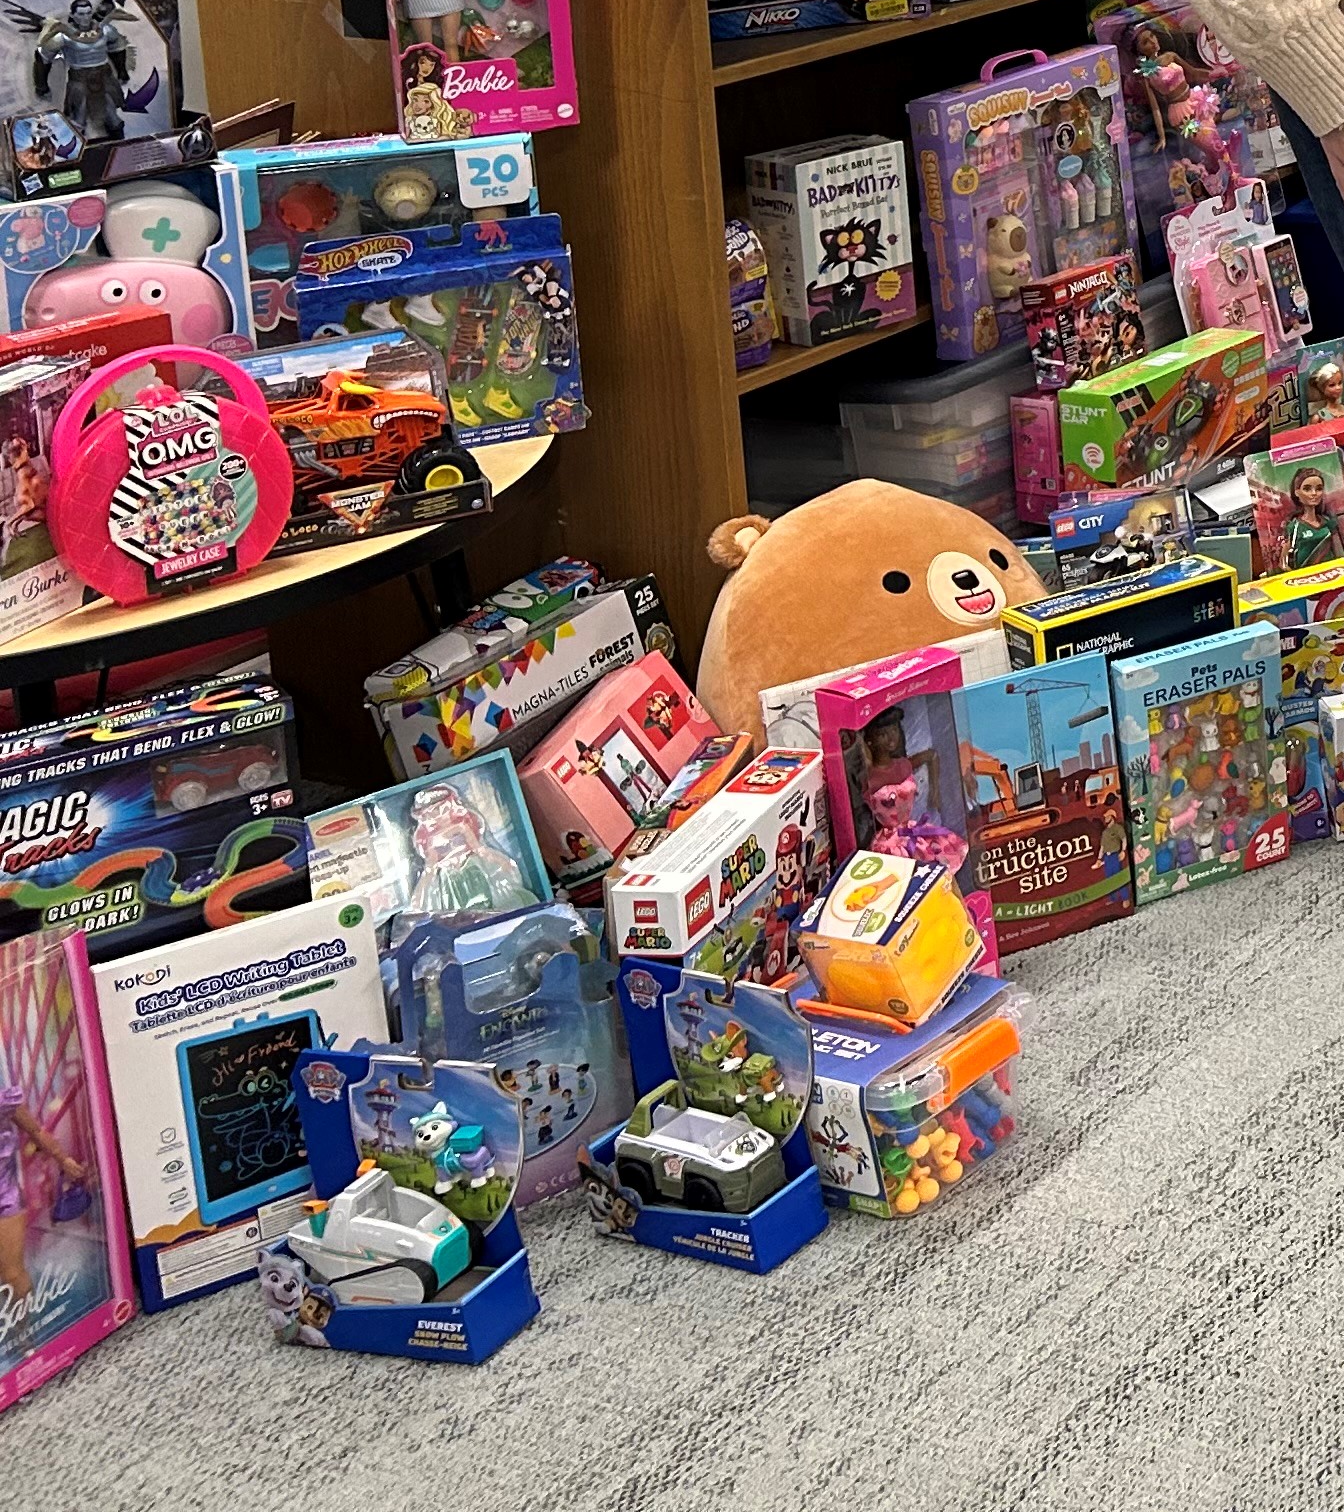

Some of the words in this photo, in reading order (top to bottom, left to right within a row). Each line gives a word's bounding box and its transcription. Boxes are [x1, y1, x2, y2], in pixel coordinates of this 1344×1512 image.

[745, 6, 801, 29] NIKKO
[443, 65, 516, 101] Barbie
[466, 153, 520, 187] 20
[826, 165, 849, 176] NICK
[481, 185, 510, 199] PCS
[806, 186, 838, 208] BAD
[1068, 271, 1110, 299] NINJAGO
[1060, 404, 1108, 422] STUNT
[1060, 414, 1090, 426] CAR
[1122, 461, 1178, 490] STUNT
[330, 490, 385, 509] MONSTER
[347, 499, 373, 513] JAM
[1078, 515, 1105, 529] CITY
[161, 554, 197, 575] JEWELRY
[199, 548, 221, 562] CASE
[634, 585, 655, 607] 25
[1193, 604, 1226, 624] STEM
[588, 632, 635, 669] FOREST
[1076, 631, 1122, 653] NATIONAL
[1135, 645, 1190, 664] ERASER
[1193, 634, 1230, 651] PALS
[1191, 662, 1219, 678] Pets
[511, 665, 589, 721] MAGNA-TILES
[1143, 675, 1219, 708] ERASER
[1222, 659, 1267, 687] PALS
[26, 756, 87, 783] TRACKS
[91, 746, 130, 768] THAT
[180, 723, 215, 745] FLEX
[219, 719, 232, 734] &
[234, 706, 282, 730] GLOW!
[0, 790, 89, 842] AGIC
[251, 803, 268, 816] 3+
[980, 845, 1003, 862] on
[1006, 835, 1038, 855] the
[1254, 826, 1287, 855] 25
[976, 834, 1094, 885] truction
[1255, 845, 1287, 864] COUNT
[688, 893, 712, 924] LEGO
[721, 833, 759, 878] SUPER
[718, 847, 767, 909] MARIO
[1019, 861, 1070, 894] site
[46, 891, 107, 923] GLOWS
[113, 883, 135, 904] IN
[636, 907, 657, 919] LEGO
[84, 904, 140, 933] DARK!
[623, 935, 674, 951] MARIO
[628, 926, 667, 938] SUPER
[138, 986, 184, 1015] Kids'
[186, 978, 224, 1000] LCD
[224, 959, 289, 989] Writing
[291, 941, 343, 969] Tablet
[130, 1009, 187, 1034] Tablette
[187, 999, 217, 1016] LCD
[305, 957, 357, 980] enfants
[833, 1047, 867, 1062] SET
[709, 1227, 751, 1243] TRACKER
[416, 1319, 464, 1333] EVEREST
